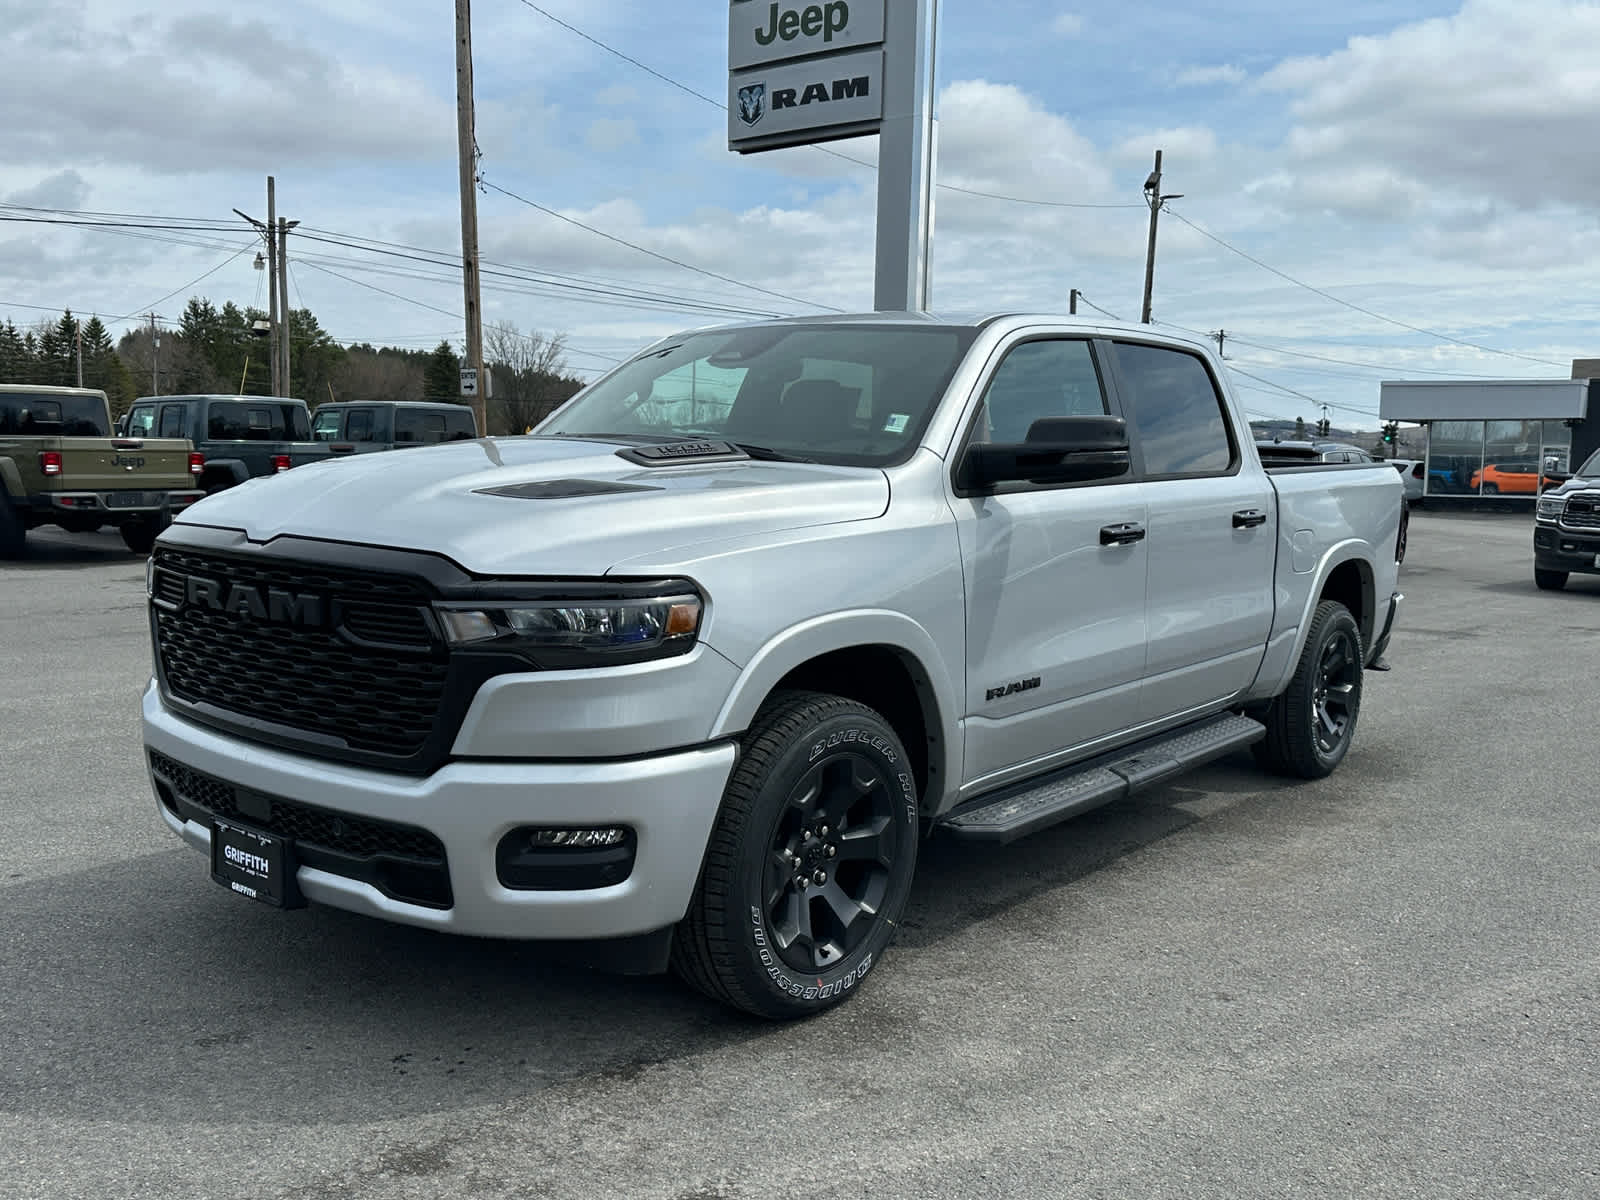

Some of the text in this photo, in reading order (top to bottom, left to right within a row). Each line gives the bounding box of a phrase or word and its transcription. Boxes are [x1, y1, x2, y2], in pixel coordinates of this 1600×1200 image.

[754, 0, 849, 46] Jeep
[771, 75, 869, 110] RAM
[111, 455, 145, 468] Jeep
[187, 574, 322, 627] RAM
[985, 677, 1041, 701] RAM
[809, 729, 897, 763] DUELER
[224, 844, 269, 873] GRIFFITH
[231, 881, 257, 898] GRIFFITH
[751, 905, 873, 1000] BRIDGESTONE
